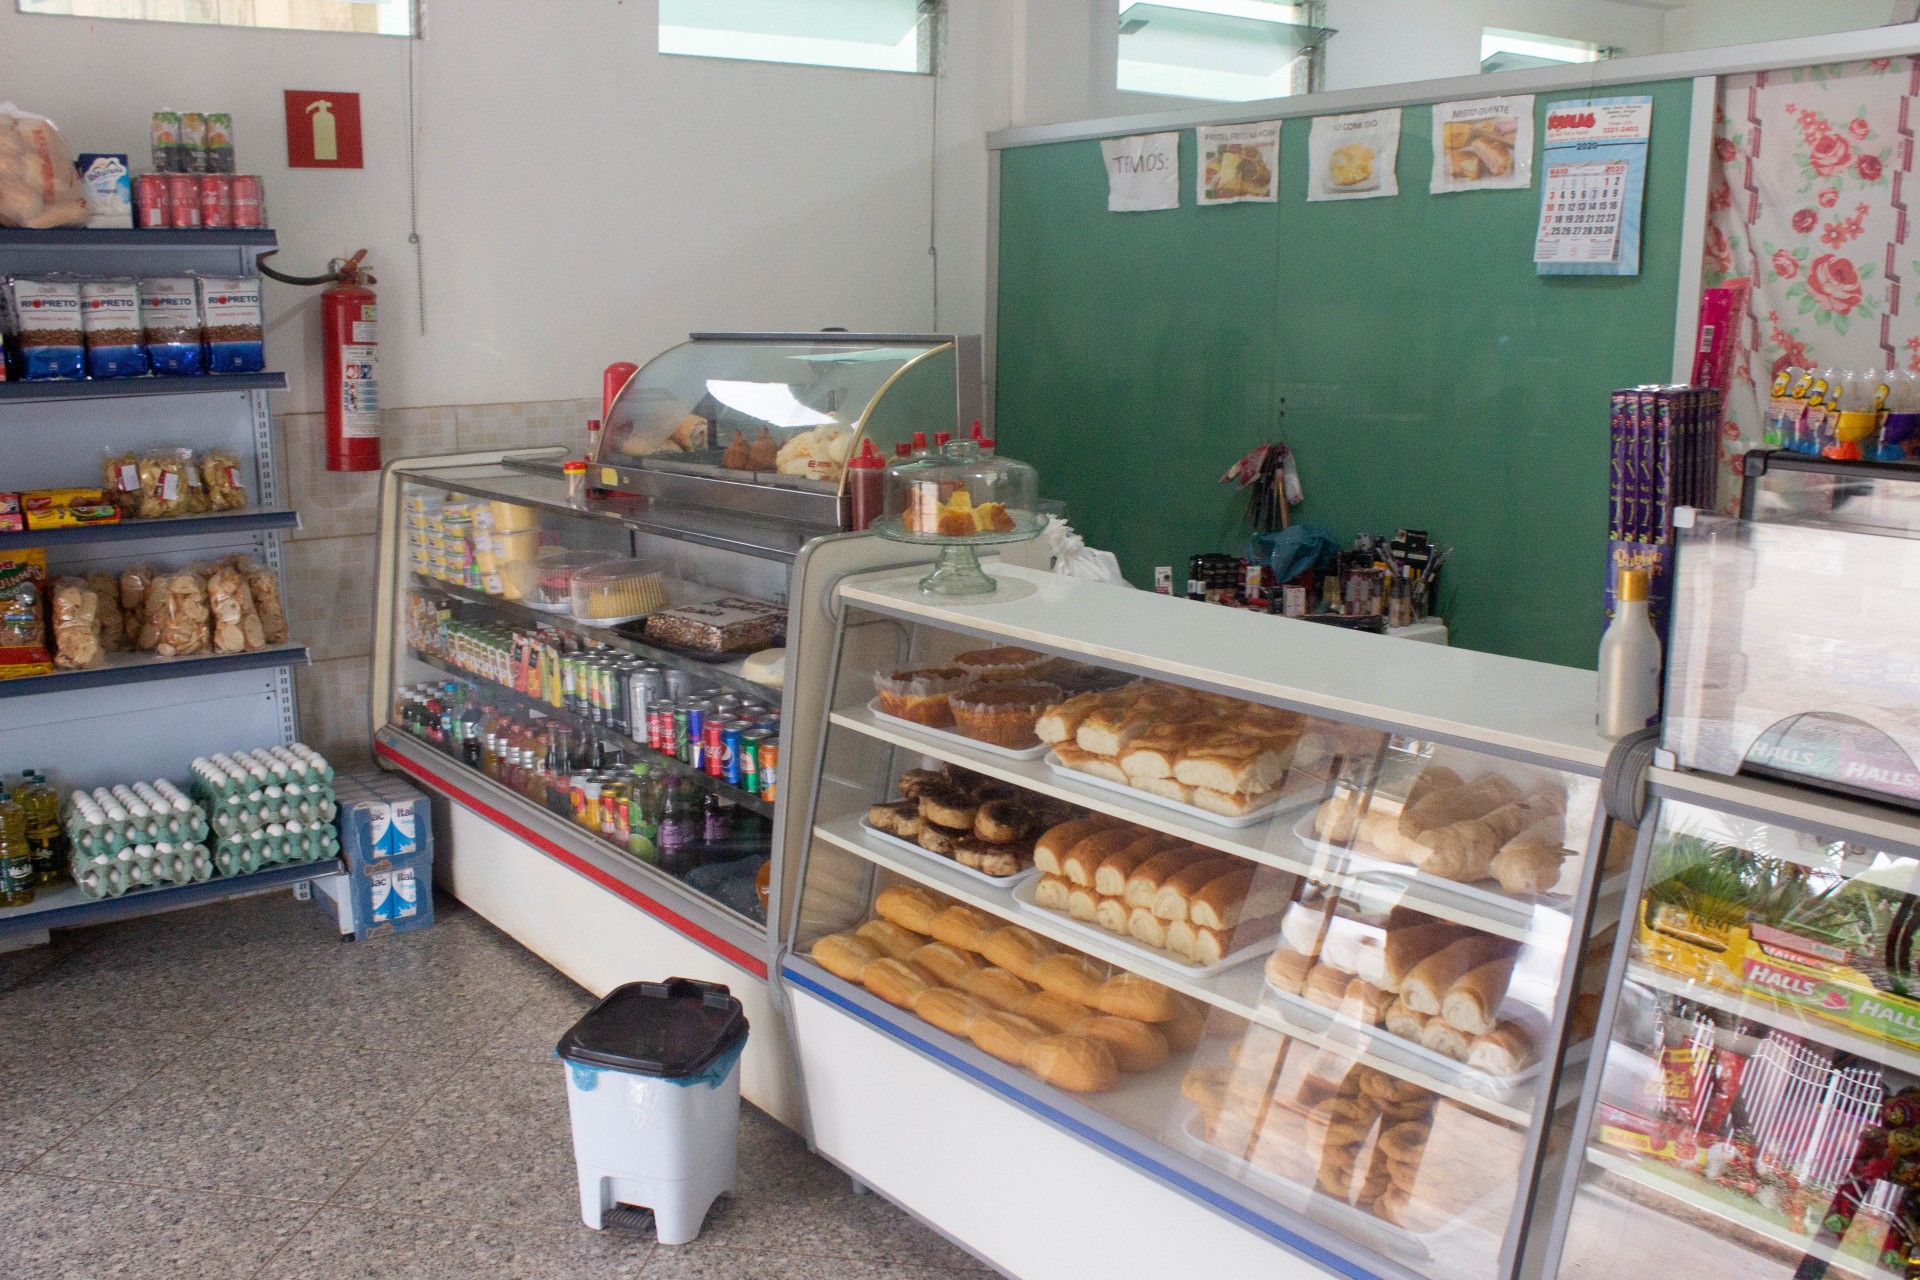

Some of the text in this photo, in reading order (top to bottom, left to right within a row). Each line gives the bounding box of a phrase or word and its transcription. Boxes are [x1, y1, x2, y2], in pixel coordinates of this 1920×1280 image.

[1452, 105, 1510, 118] MISTO QUENTE
[1576, 142, 1598, 151] 2020
[1546, 201, 1618, 212] 10 11 12 13 14 15 16
[1544, 214, 1616, 224] 17 18 19 20 21 22 23
[1551, 226, 1561, 236] 25
[1561, 226, 1572, 236] 26
[1572, 226, 1581, 236] 27
[1582, 226, 1592, 235] 28
[1593, 226, 1603, 234] 29
[1603, 226, 1614, 234] 30
[1751, 741, 1815, 767] HALLS
[1845, 761, 1917, 788] HALLS
[1749, 964, 1817, 997] HALLS
[1857, 999, 1920, 1031] HALL
